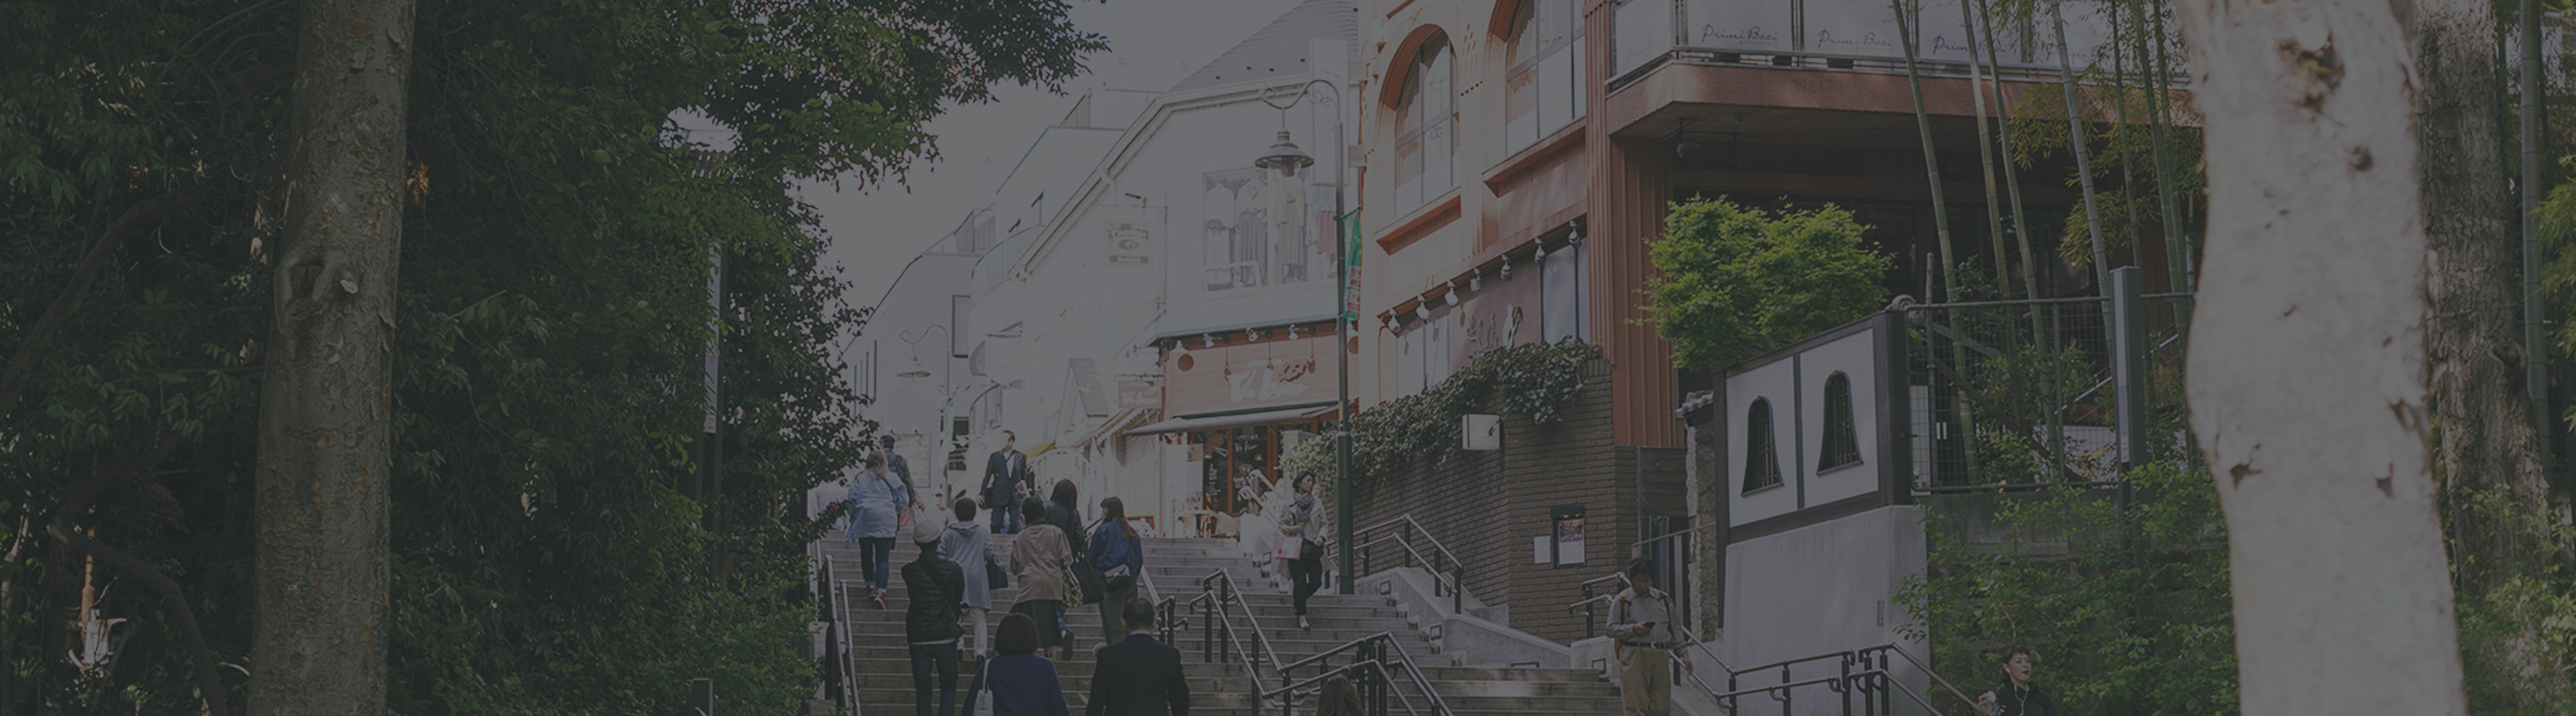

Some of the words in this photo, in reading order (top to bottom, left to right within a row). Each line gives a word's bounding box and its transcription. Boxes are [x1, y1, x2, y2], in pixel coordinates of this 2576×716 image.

[1701, 22, 1745, 42] Primi
[1747, 26, 1778, 40] Baci
[1818, 29, 1860, 48] Primi
[1863, 31, 1894, 47] Baci
[1932, 34, 1970, 55] Prim
